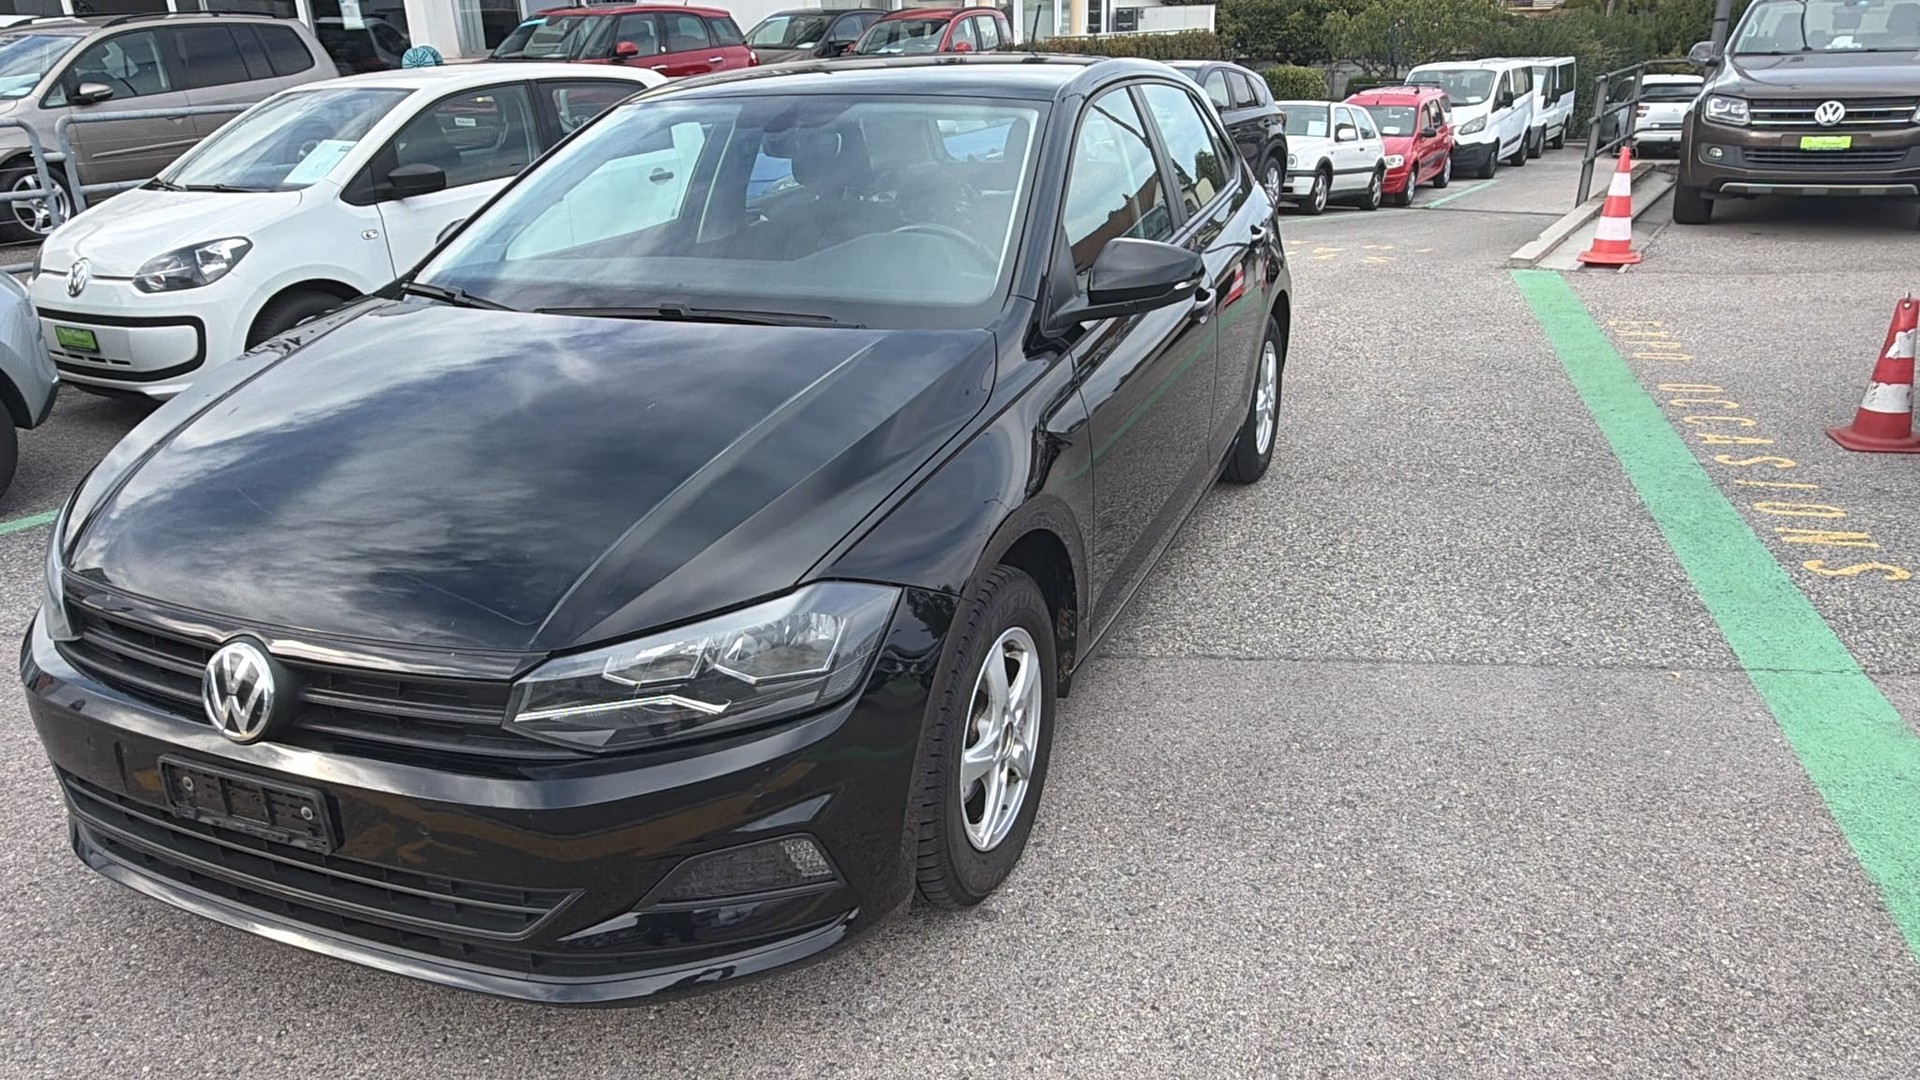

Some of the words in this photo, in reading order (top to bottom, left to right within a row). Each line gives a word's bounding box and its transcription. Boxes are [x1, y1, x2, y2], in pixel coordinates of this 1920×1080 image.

[1816, 102, 1844, 125] VW
[1657, 383, 1912, 581] OCCASIONS
[204, 643, 273, 740] VW
